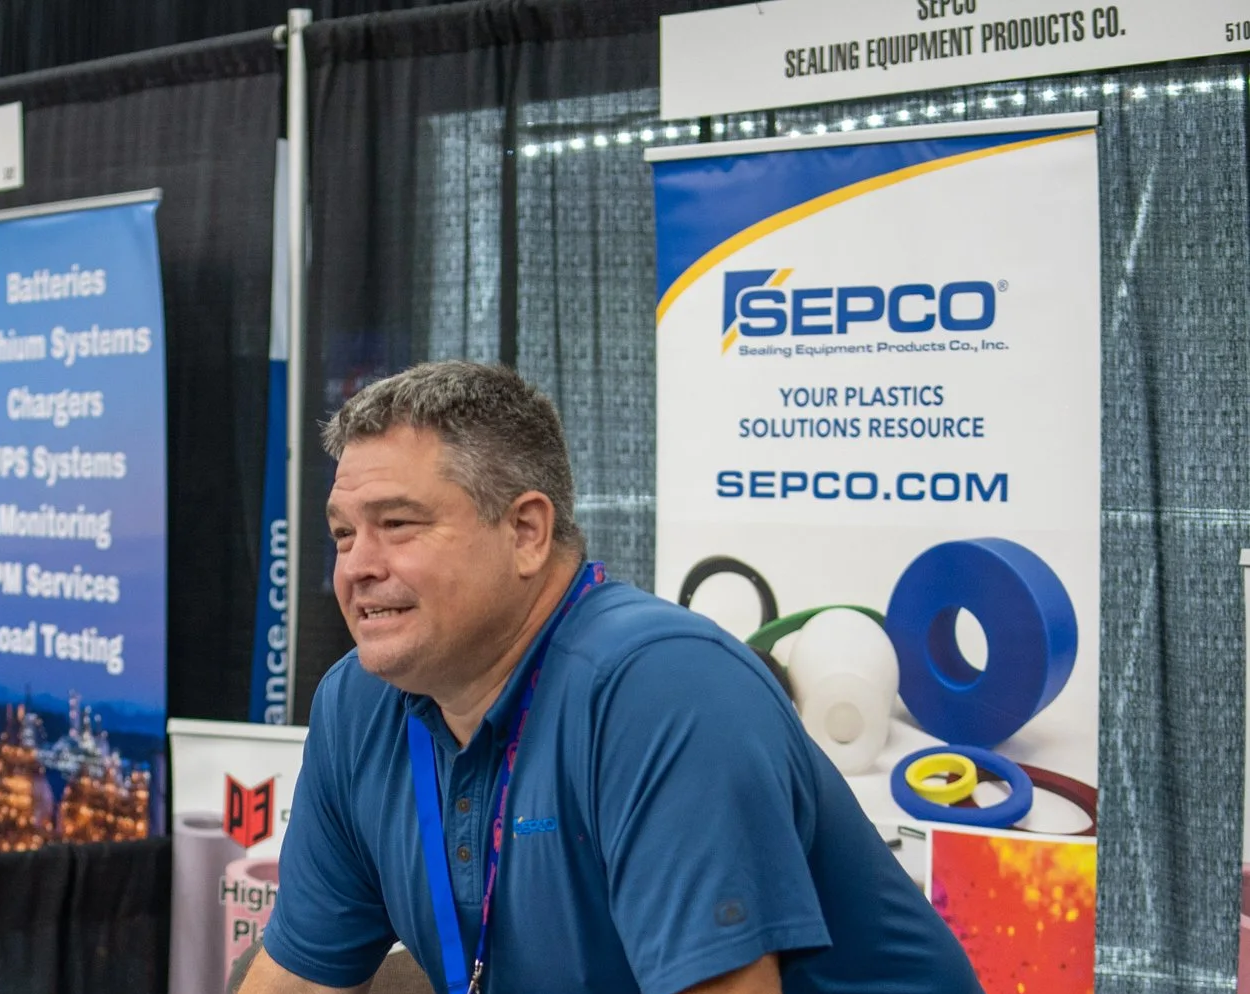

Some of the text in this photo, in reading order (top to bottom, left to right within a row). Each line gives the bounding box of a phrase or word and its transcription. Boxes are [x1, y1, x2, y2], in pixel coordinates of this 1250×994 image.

[785, 6, 1126, 78] SEALING EQUIPMENT PRODUCTS CO.
[6, 263, 106, 304] Batteries
[738, 280, 996, 337] SEPCO
[51, 324, 152, 367] Systems
[738, 345, 792, 358] Sealing
[796, 343, 873, 357] Equipment
[877, 341, 946, 353] Products
[982, 339, 1009, 351] Inc.
[7, 386, 104, 428] Chargers
[779, 385, 944, 407] YOUR PLASTICS
[739, 417, 985, 438] SOLUTIONS RESOURCE
[33, 446, 127, 487] Systems
[716, 470, 1009, 502] SEPCO.COM
[26, 563, 120, 604] Services
[40, 624, 124, 675] Testing
